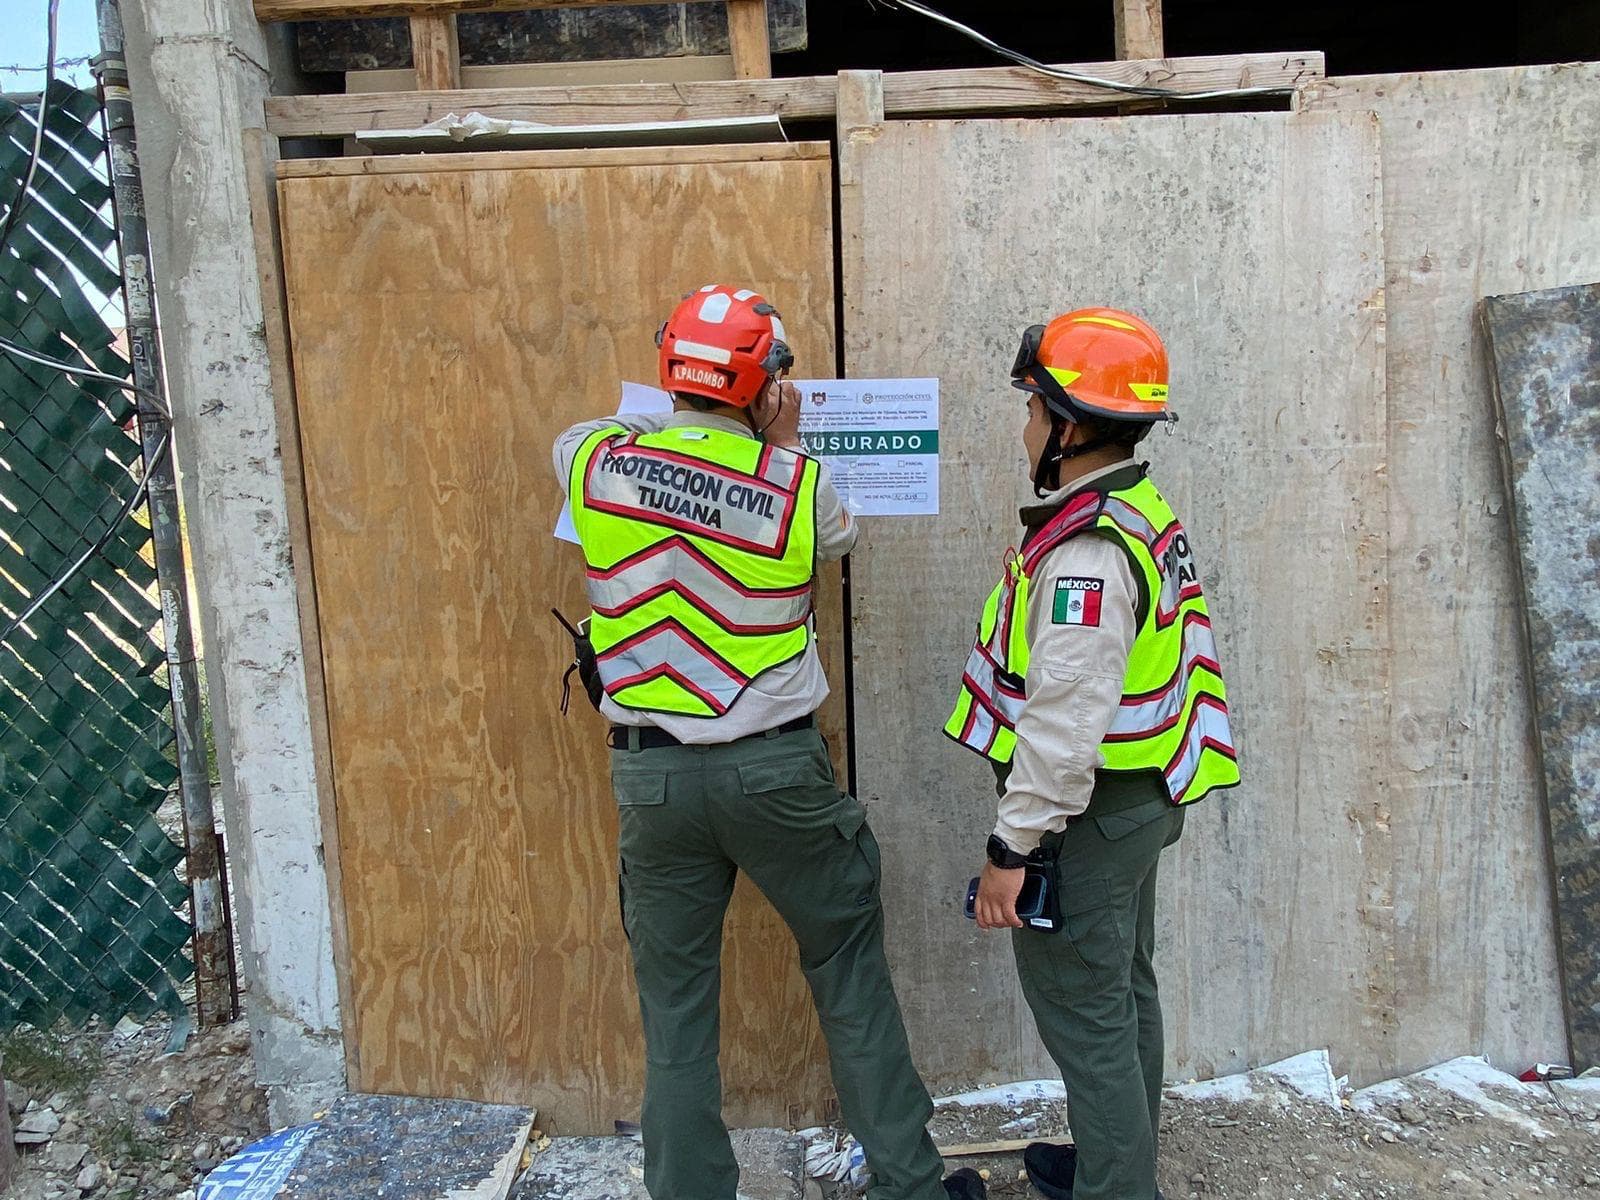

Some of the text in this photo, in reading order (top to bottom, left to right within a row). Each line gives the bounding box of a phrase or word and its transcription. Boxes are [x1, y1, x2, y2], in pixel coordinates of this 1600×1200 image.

[601, 451, 775, 519] PROTECCION CIVIL
[638, 485, 722, 529] TIJUANA
[1057, 578, 1101, 591] MÉXICO
